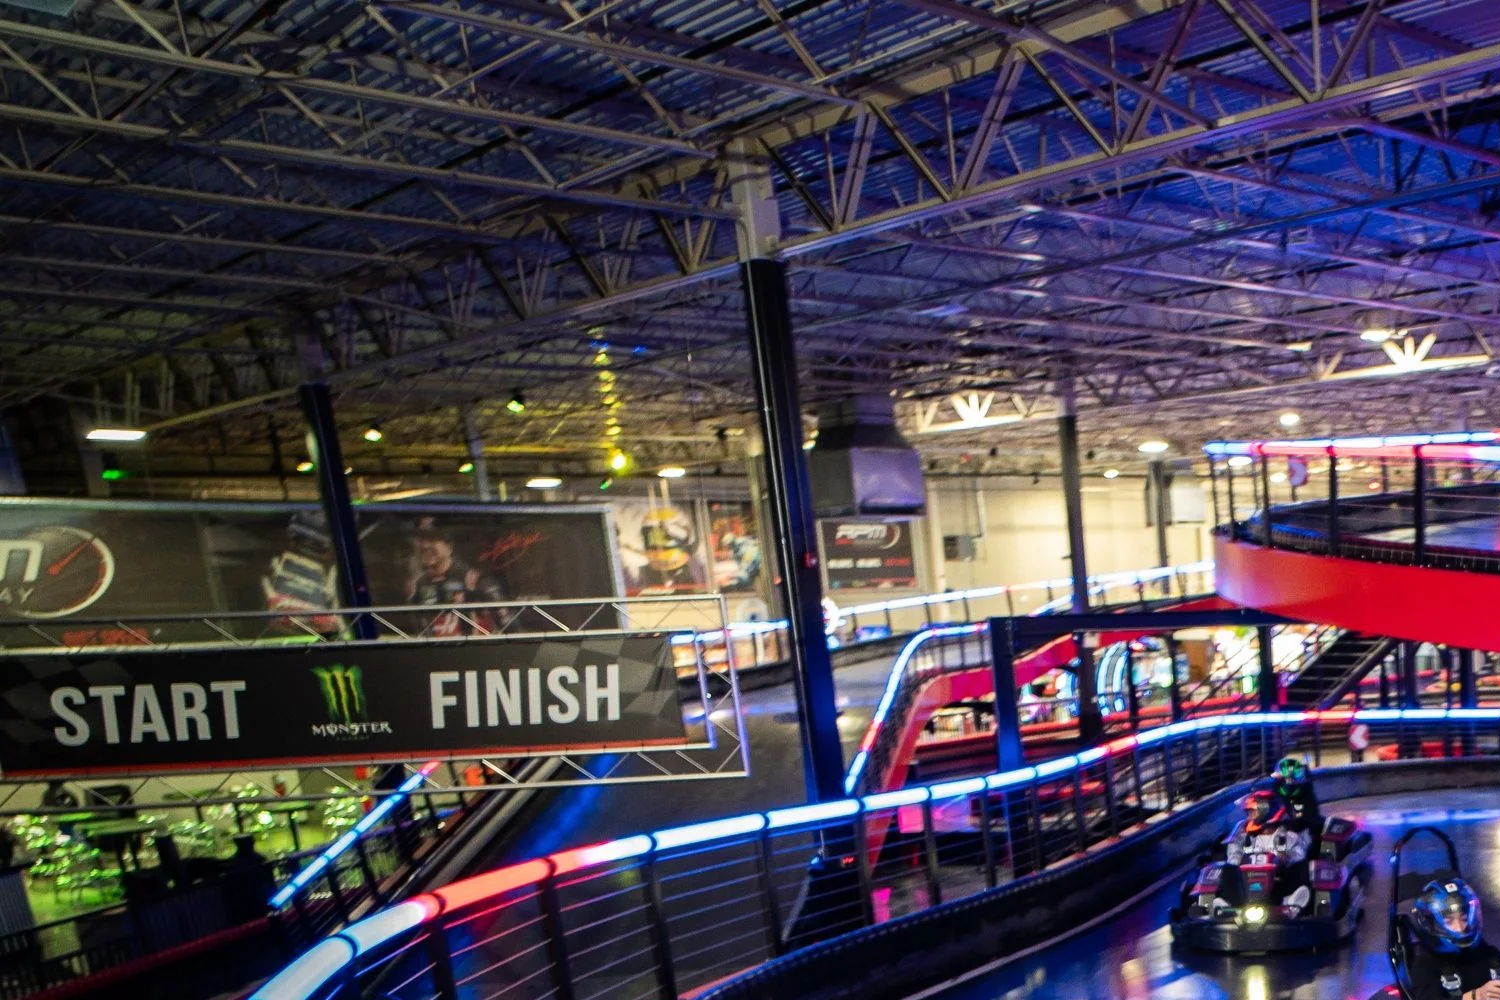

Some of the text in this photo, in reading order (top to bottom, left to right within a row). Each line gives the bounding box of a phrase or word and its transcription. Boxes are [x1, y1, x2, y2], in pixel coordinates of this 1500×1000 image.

[50, 664, 621, 746] START FINISH
[312, 721, 393, 737] MONSTER
